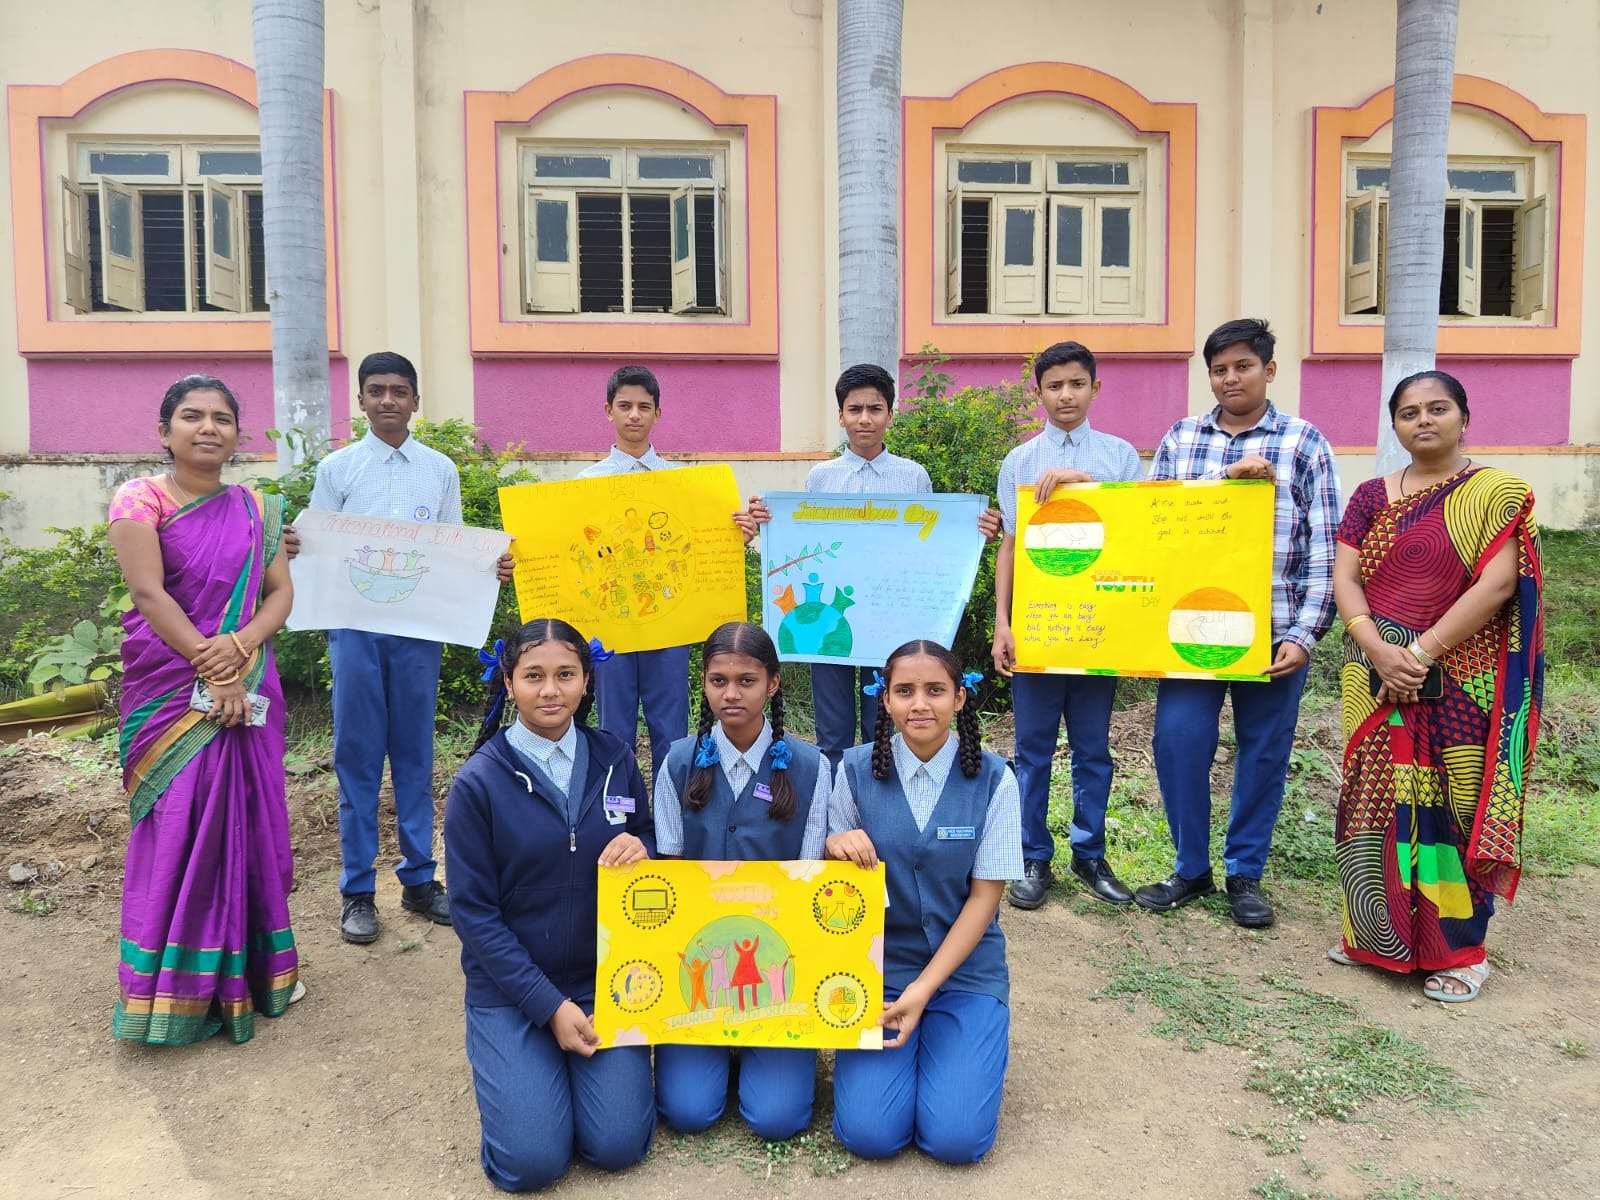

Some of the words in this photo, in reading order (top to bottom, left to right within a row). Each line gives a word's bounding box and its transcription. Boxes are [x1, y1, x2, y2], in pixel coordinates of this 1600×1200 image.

[1090, 575, 1155, 593] YOUTH
[1047, 621, 1071, 636] nothing
[712, 884, 775, 904] YOUTH
